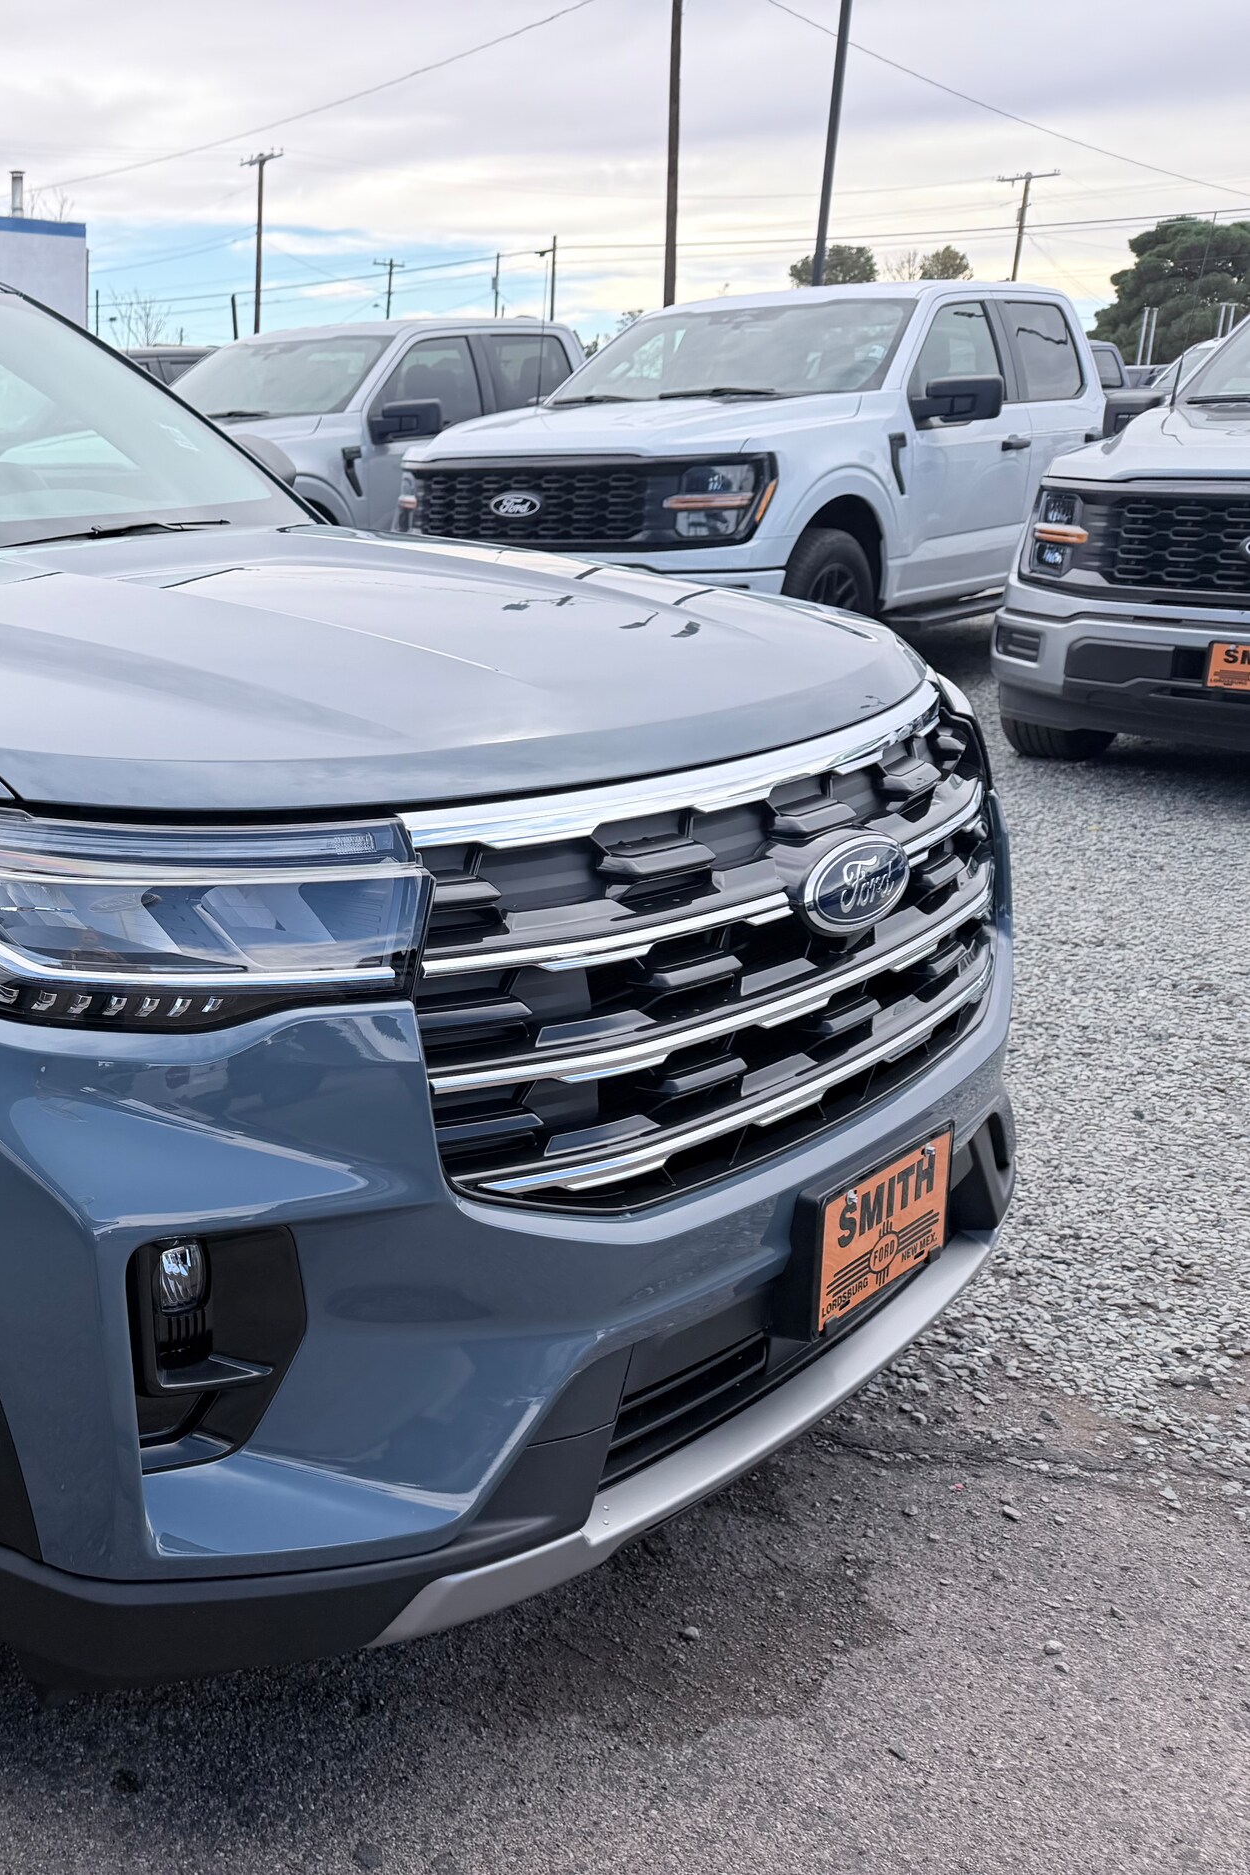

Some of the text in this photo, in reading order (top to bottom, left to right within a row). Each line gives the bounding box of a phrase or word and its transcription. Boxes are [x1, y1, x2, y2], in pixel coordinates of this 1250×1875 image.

[499, 498, 531, 513] Ford
[840, 855, 895, 914] Ford
[837, 1154, 936, 1248] SMITH
[821, 1277, 869, 1318] LORDSBURG
[901, 1245, 919, 1263] NEW
[873, 1239, 896, 1267] FORD
